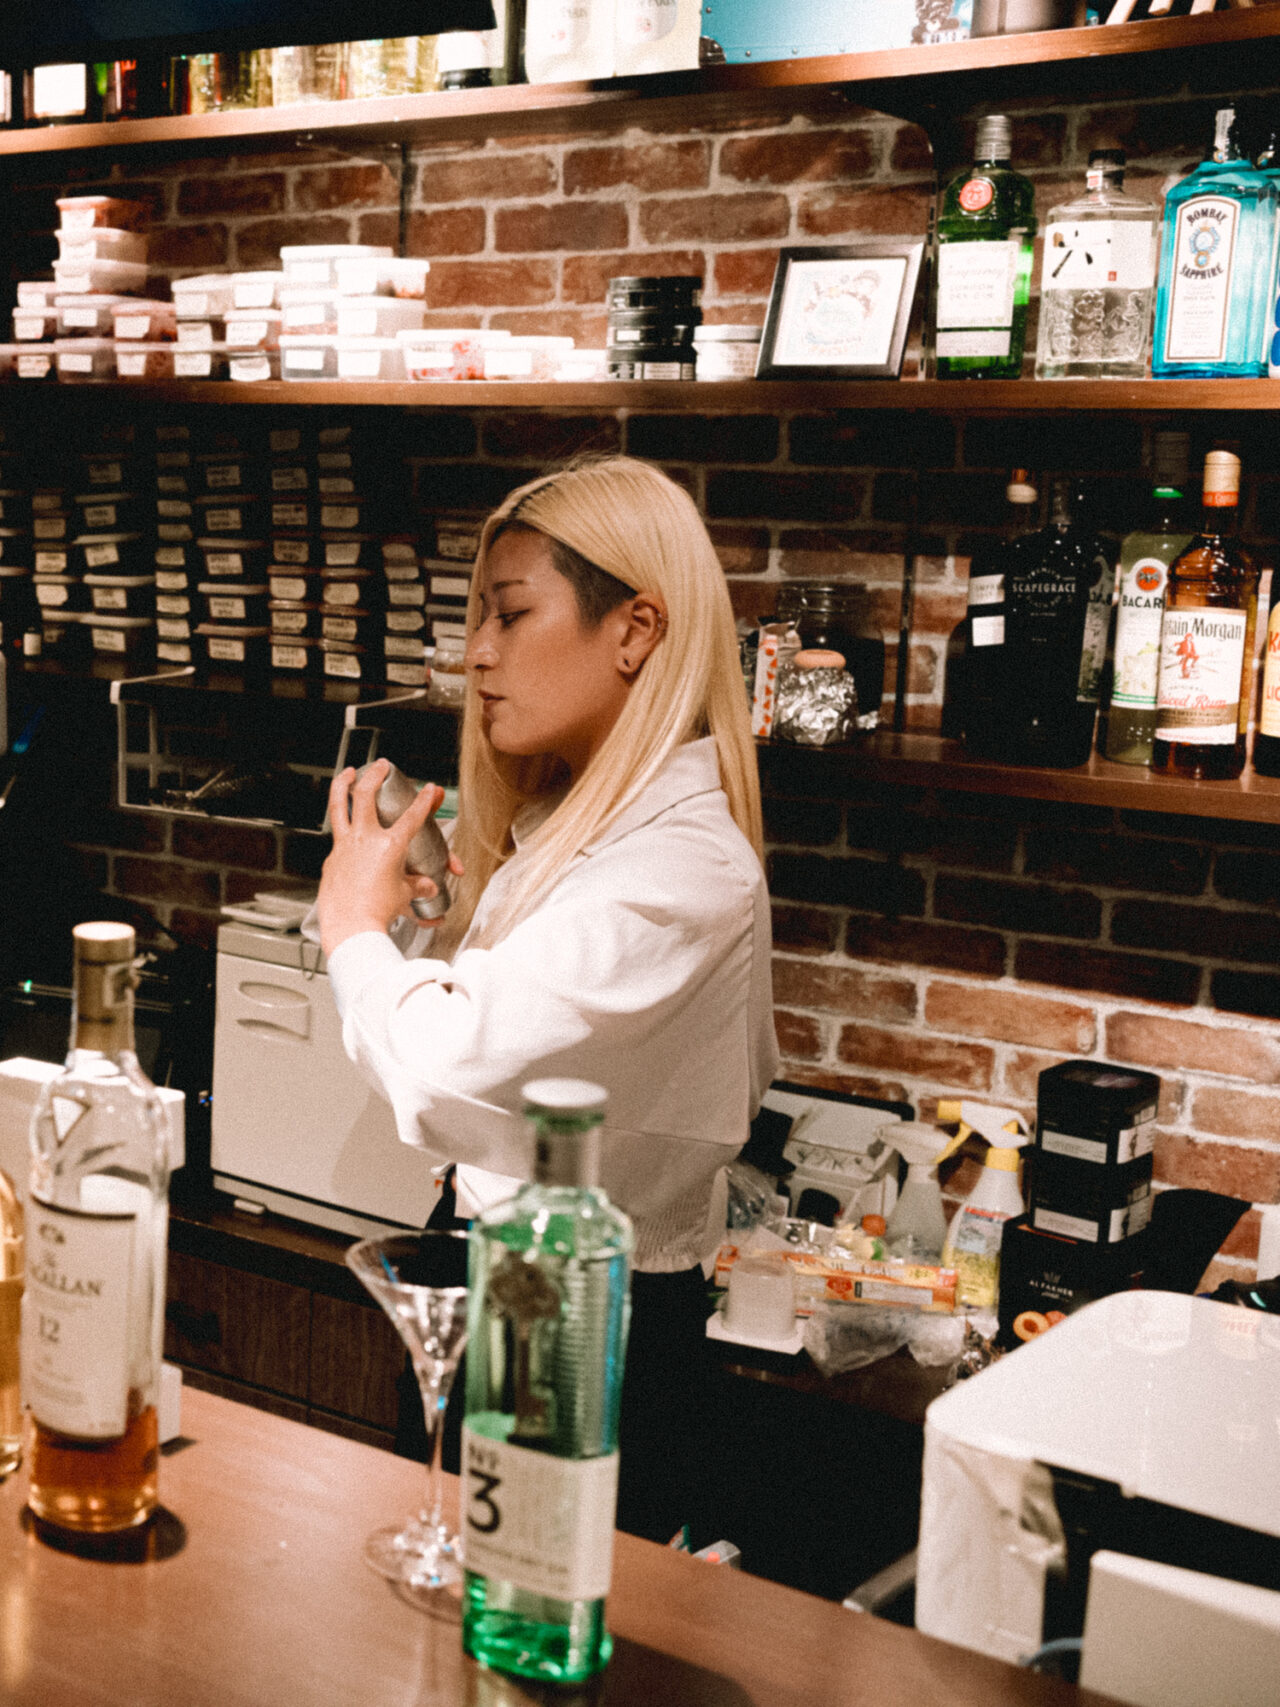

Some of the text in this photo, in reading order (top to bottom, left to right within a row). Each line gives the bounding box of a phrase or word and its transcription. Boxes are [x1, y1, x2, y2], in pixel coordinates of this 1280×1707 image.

[1186, 207, 1228, 226] BOMBAY
[1179, 261, 1224, 280] SAPPHIRE
[1012, 583, 1077, 593] SCAPEGRACE
[1122, 595, 1165, 609] BACAR
[1192, 618, 1242, 641] Morgan
[1192, 694, 1228, 710] Rum
[38, 1313, 61, 1344] 12
[467, 1468, 502, 1534] 3
